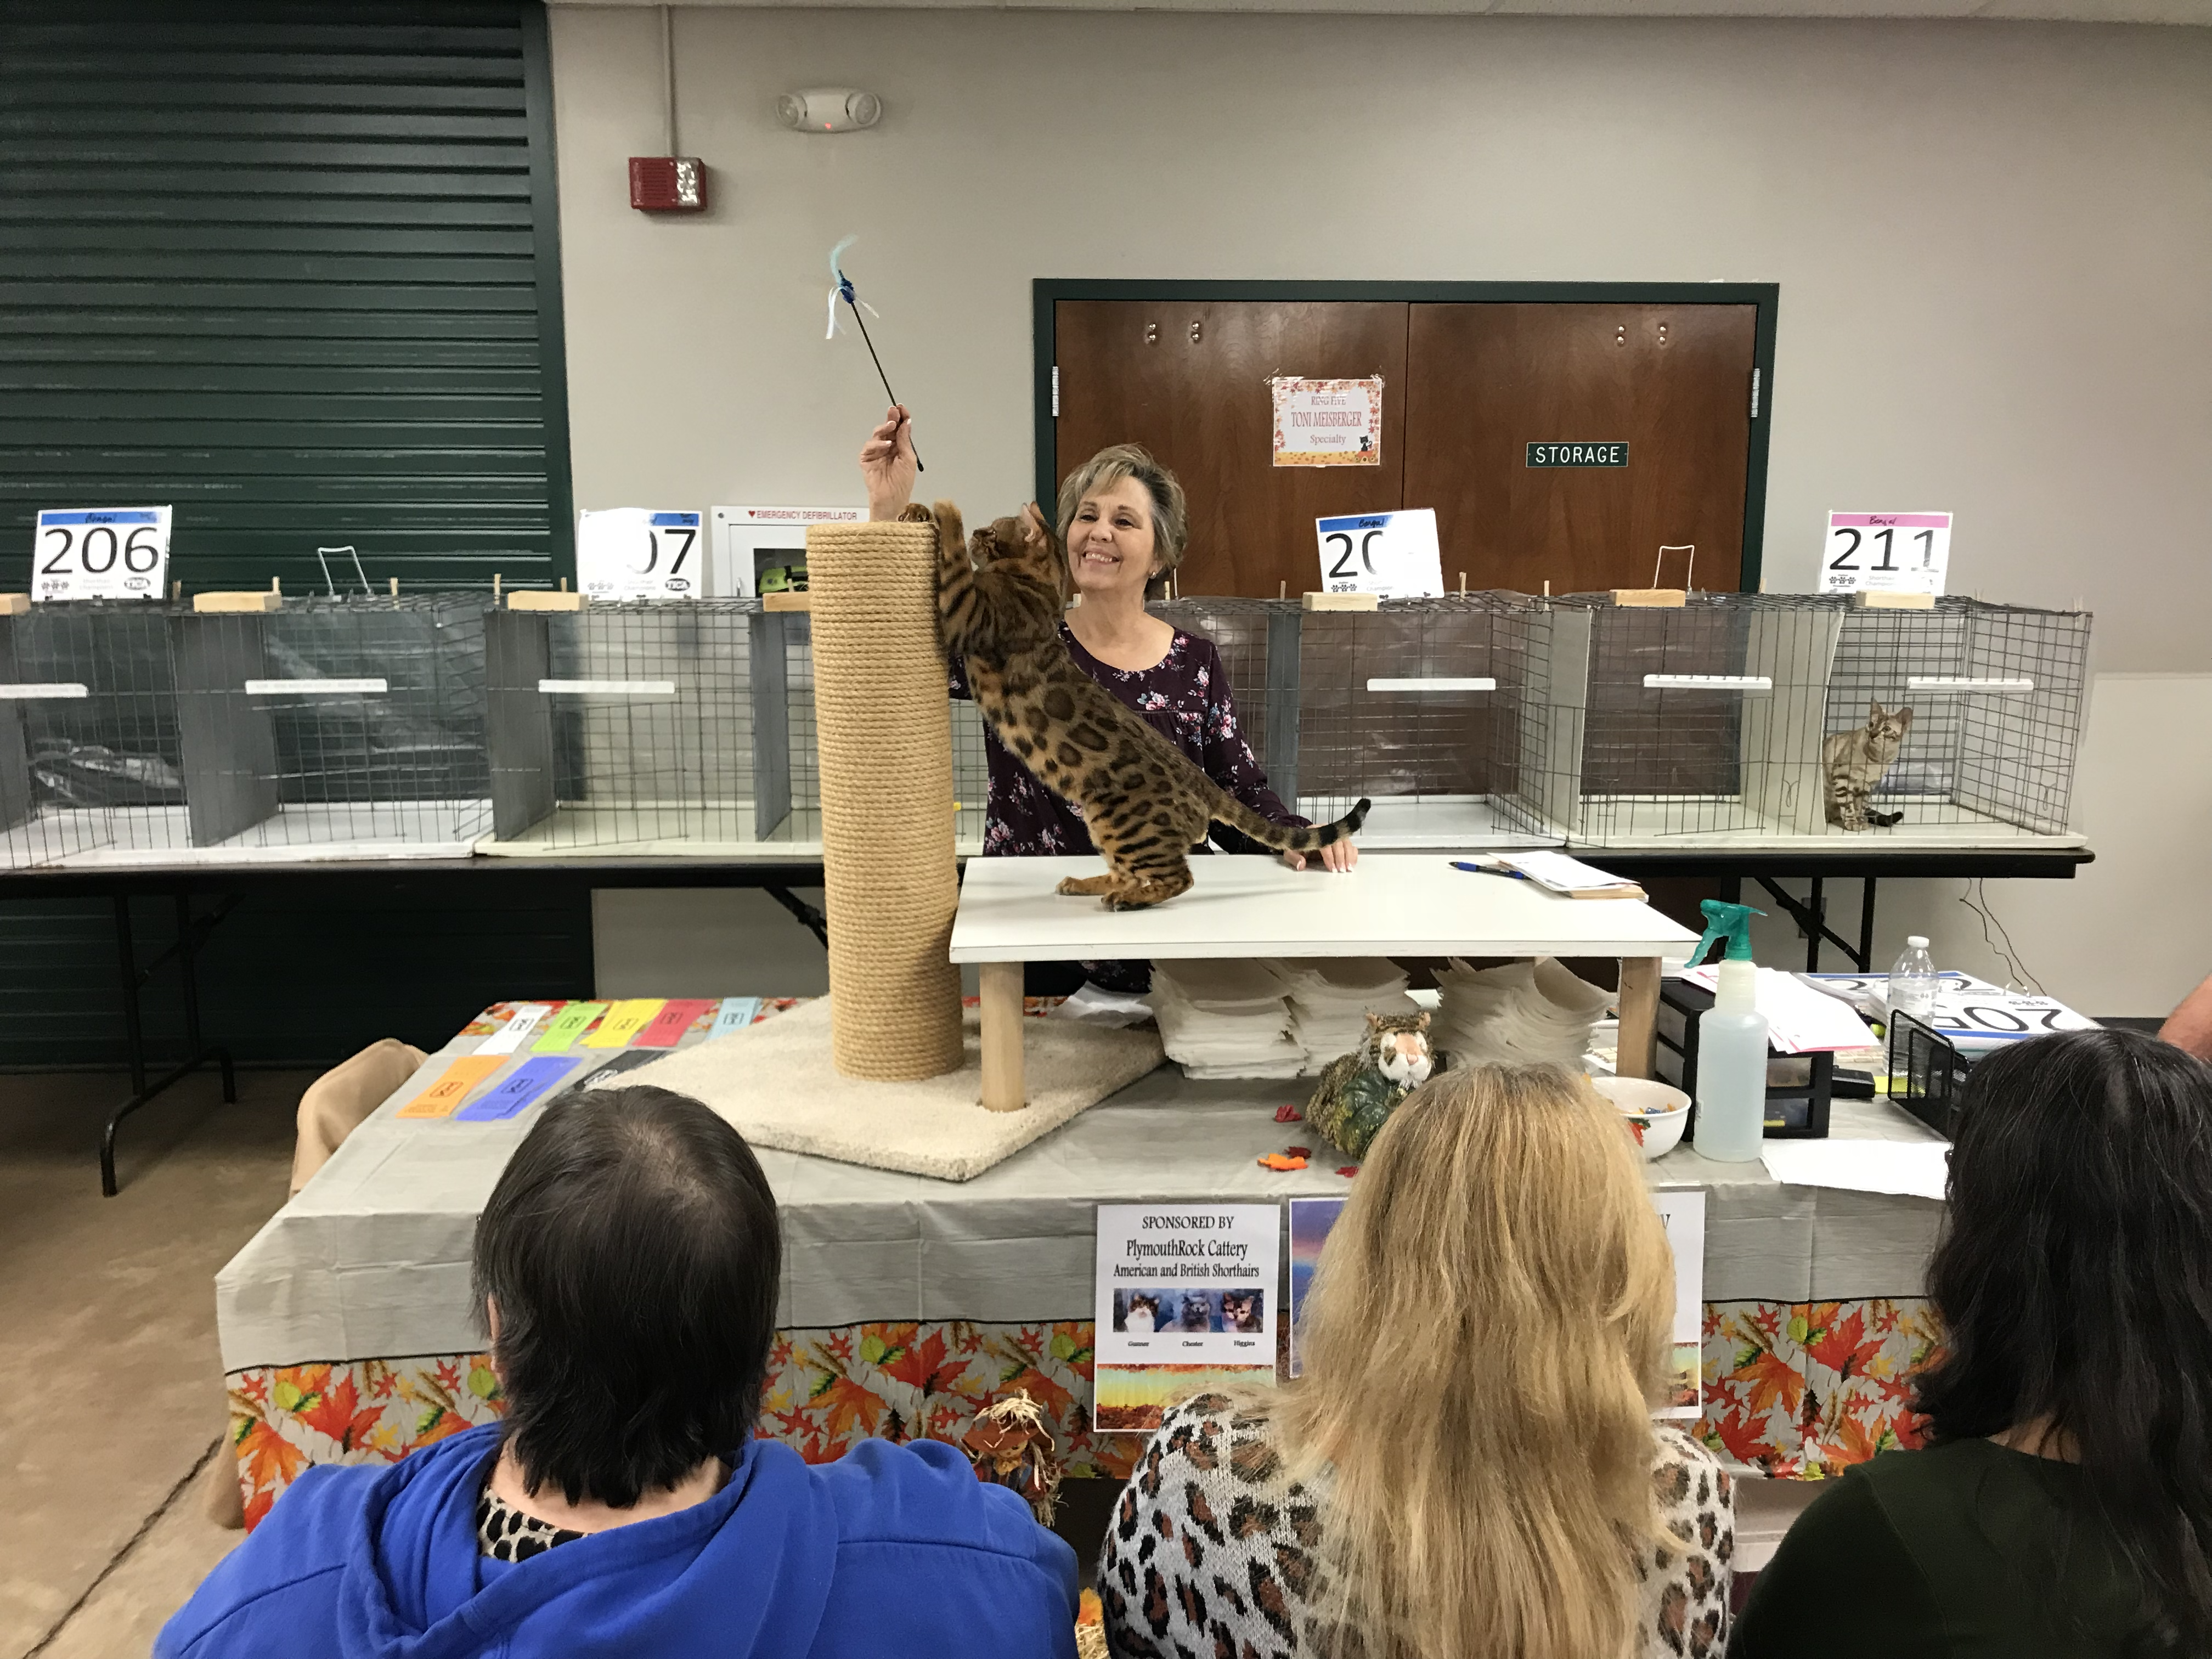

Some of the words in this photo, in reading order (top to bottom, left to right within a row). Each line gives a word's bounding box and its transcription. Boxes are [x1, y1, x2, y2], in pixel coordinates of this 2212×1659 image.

[1311, 396, 1329, 405] RING
[1331, 396, 1346, 405] FIVE
[1291, 411, 1312, 427] TONI
[1313, 411, 1362, 427] MEISBERGER
[1310, 434, 1346, 445] Specialty
[1536, 447, 1620, 463] STORAGE
[757, 510, 800, 519] EMERGENCY
[803, 511, 857, 521] DEFIBRILLATOR
[1358, 518, 1385, 528] Bengal
[41, 527, 159, 574] 206
[1325, 530, 1384, 578] 20
[1830, 528, 1939, 573] 211
[666, 581, 690, 590] TICA
[1142, 1216, 1215, 1229] SPONSORED
[1218, 1216, 1234, 1229] BY
[1126, 1239, 1205, 1261] PlymouthRock
[1207, 1239, 1248, 1261] Cattery
[1113, 1263, 1158, 1277] American
[1160, 1263, 1178, 1277] and
[1180, 1263, 1210, 1277] British
[1212, 1263, 1260, 1277] Shorthairs
